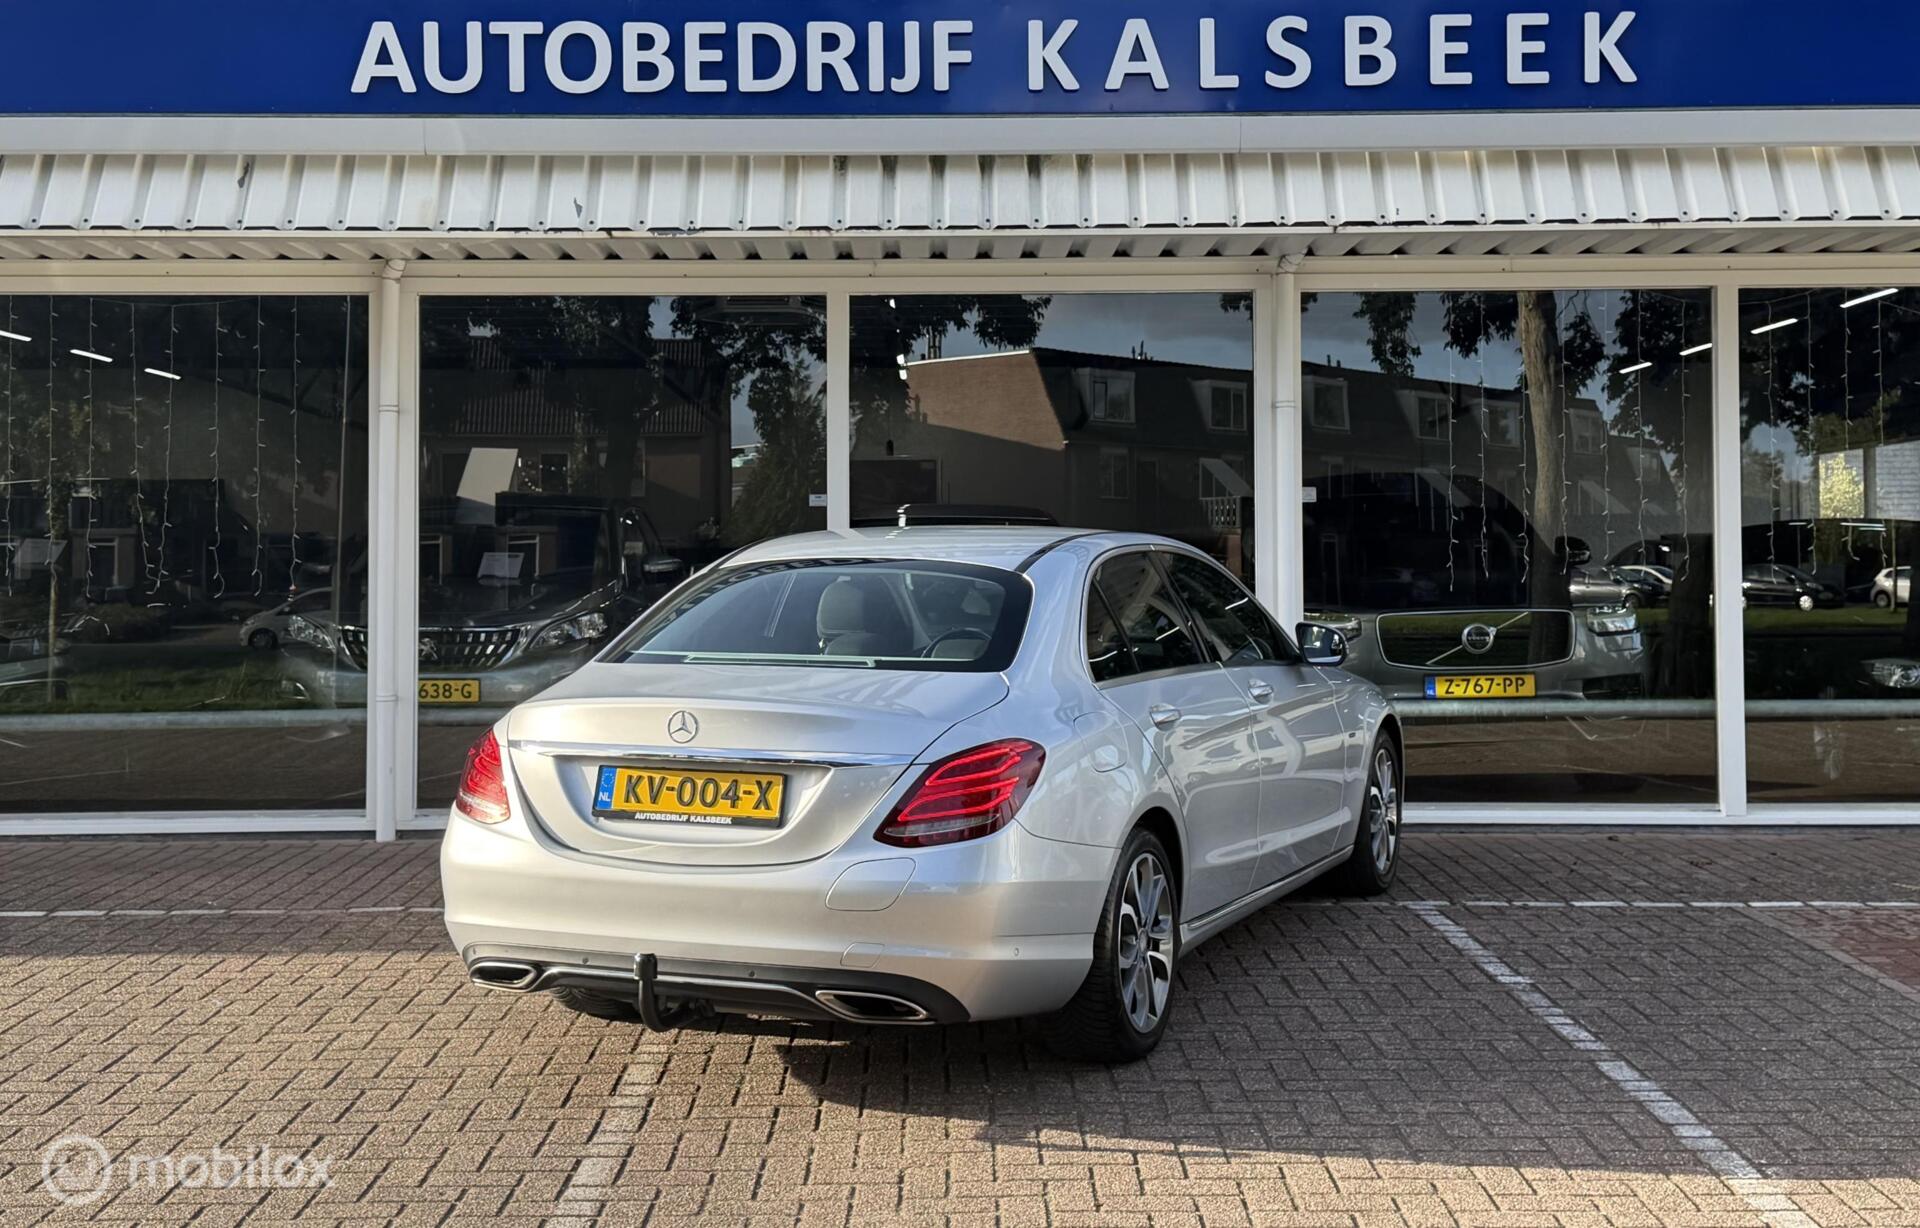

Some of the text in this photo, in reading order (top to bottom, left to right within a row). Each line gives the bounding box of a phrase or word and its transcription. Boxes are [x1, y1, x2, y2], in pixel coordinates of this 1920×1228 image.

[351, 11, 1638, 94] AUTOBEDRIJF KALSBEEK
[418, 683, 472, 699] 638-G
[1444, 677, 1525, 694] Z-767-PP
[598, 791, 611, 802] NL
[624, 774, 773, 811] KV-004-X
[634, 811, 732, 824] AUTOBEDRIJF KALSBEEK
